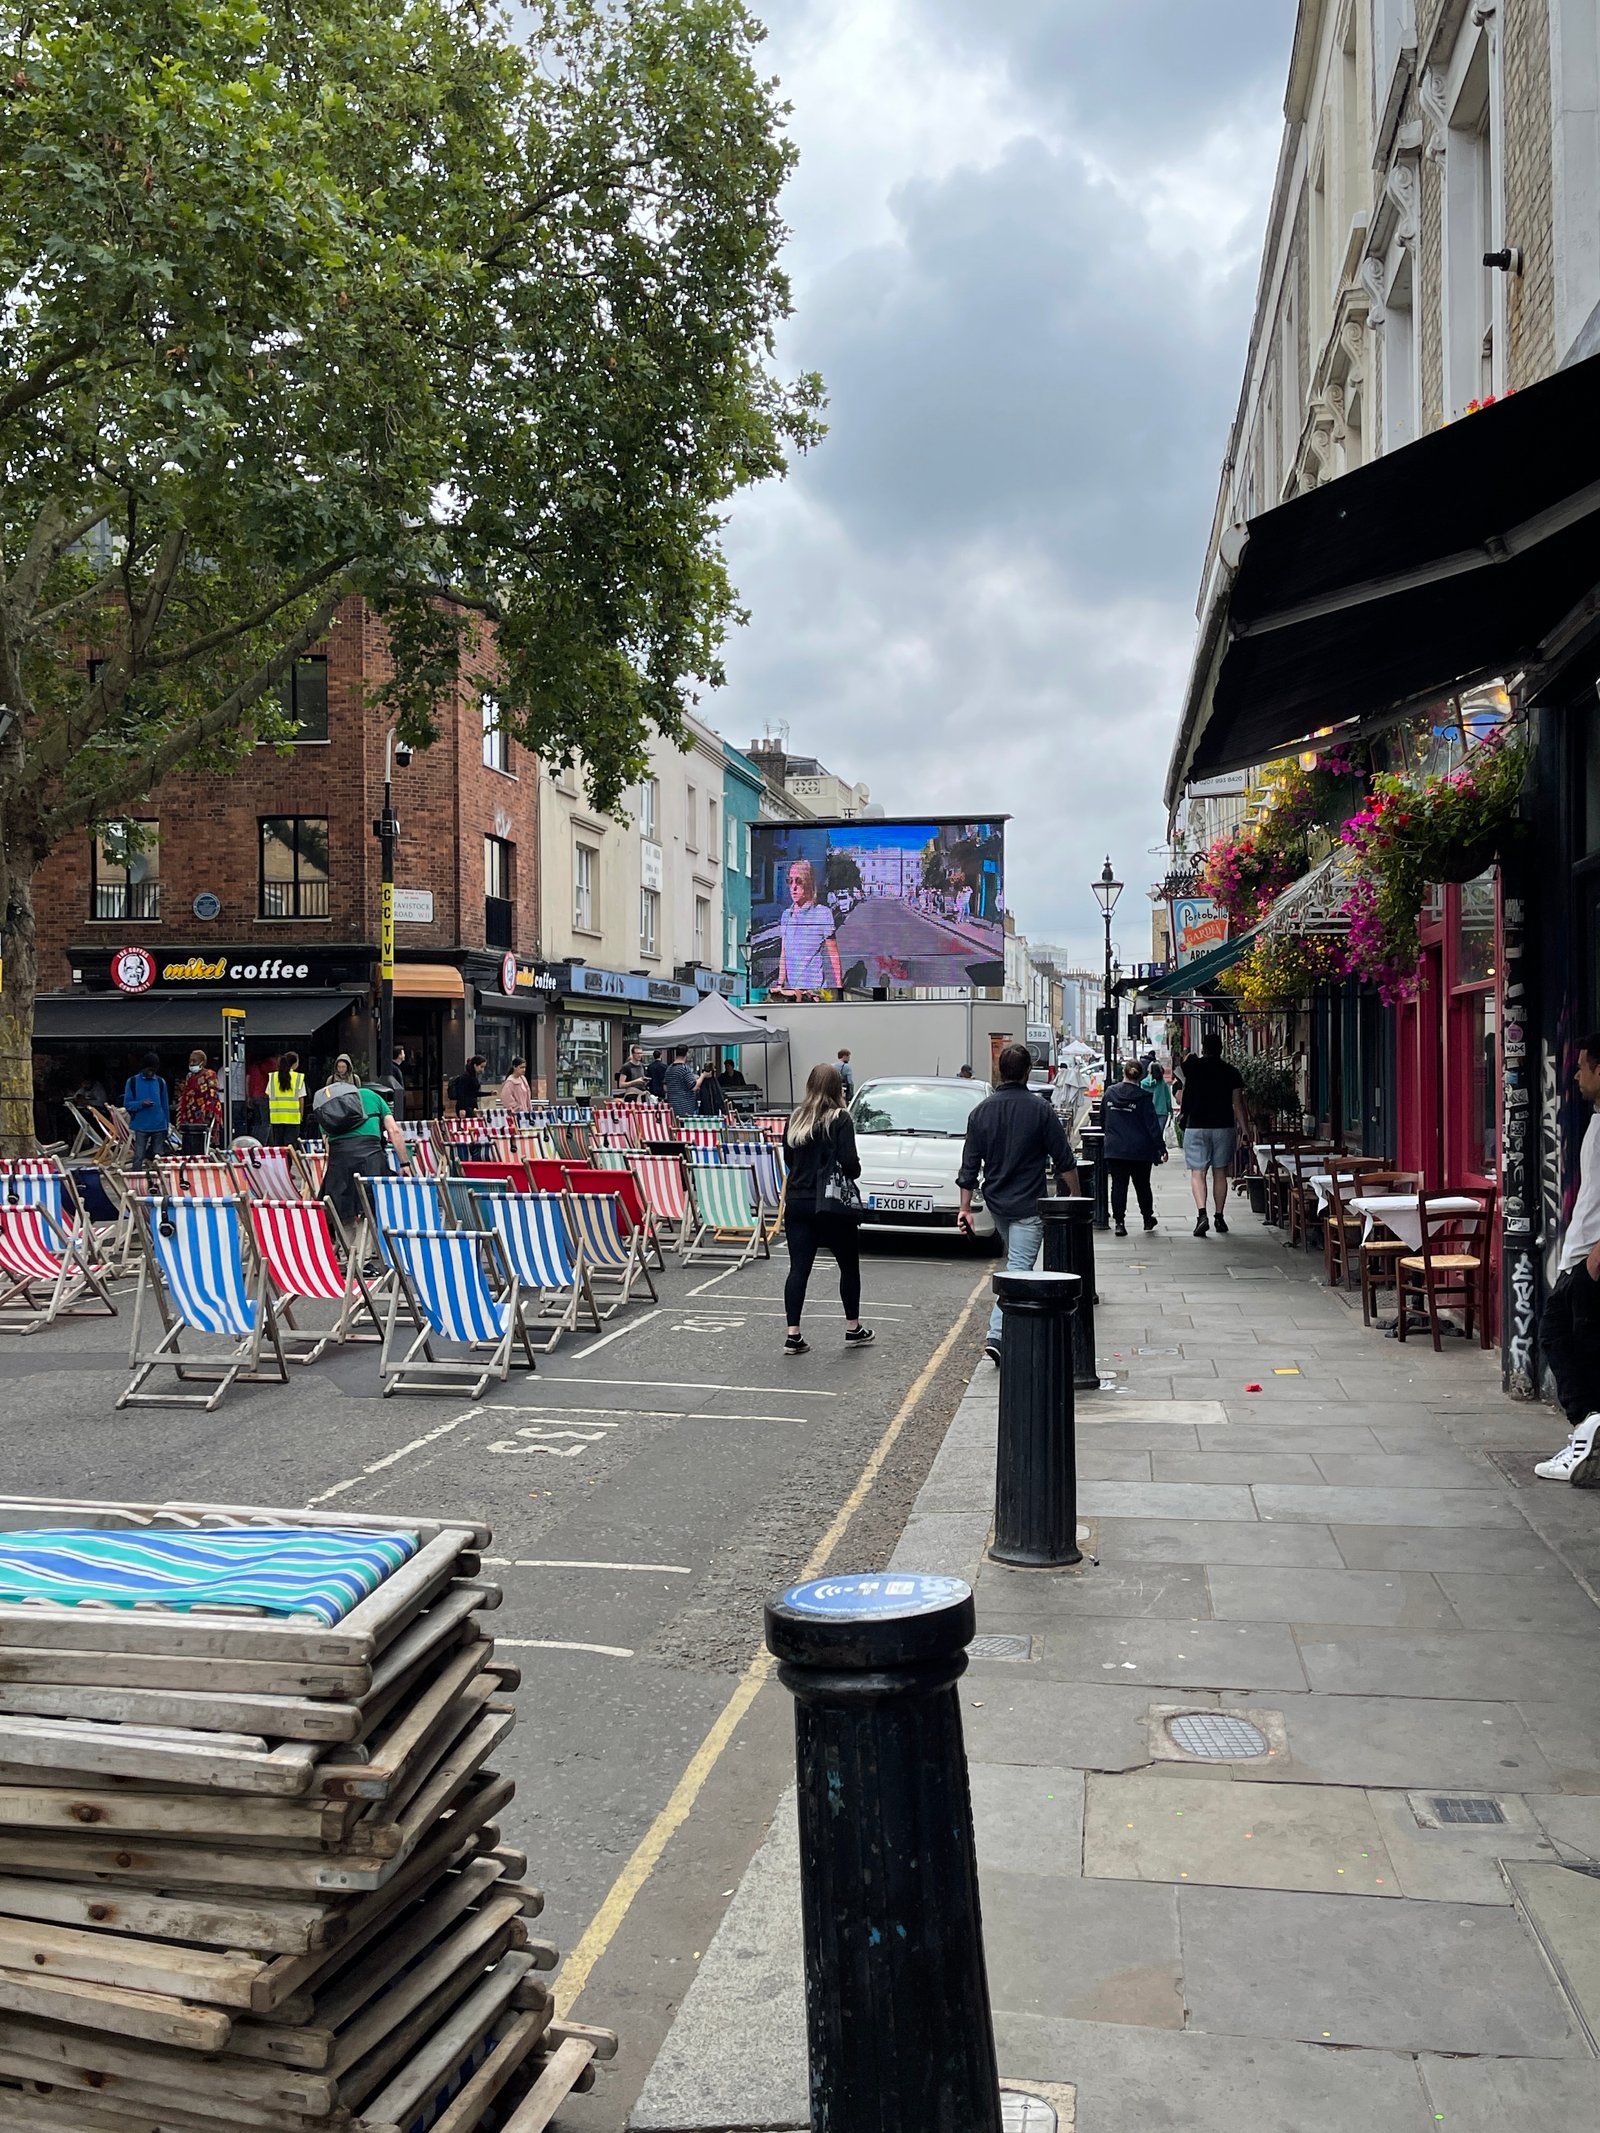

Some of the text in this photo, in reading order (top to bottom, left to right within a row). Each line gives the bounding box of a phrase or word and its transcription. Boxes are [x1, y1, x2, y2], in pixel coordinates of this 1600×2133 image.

[393, 902, 431, 911] TAVISTOCK
[393, 910, 414, 919] ROAD
[383, 888, 392, 955] CCTV
[1186, 923, 1222, 942] GARDEN
[162, 957, 309, 980] mikel coffee
[534, 972, 557, 990] coffee
[876, 1198, 931, 1211] EX08 KFJ
